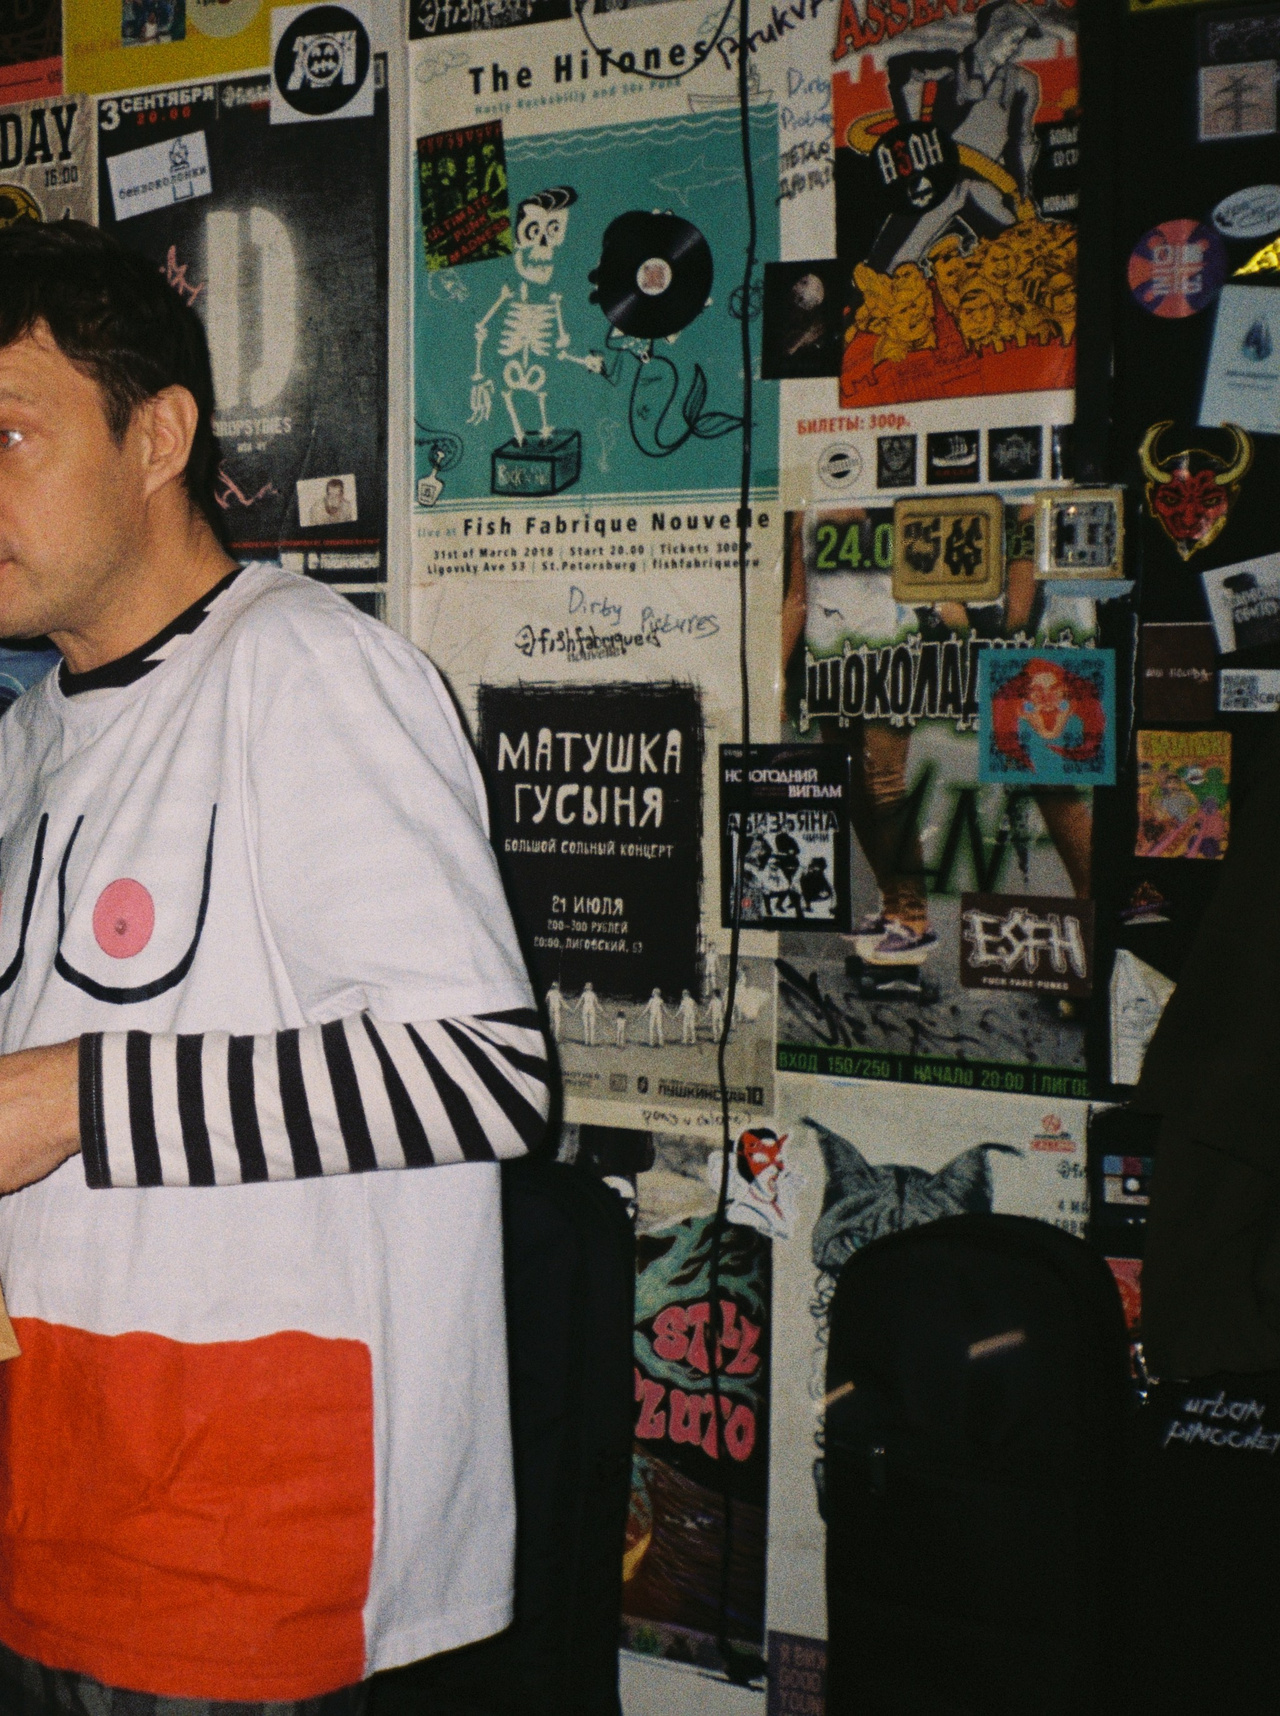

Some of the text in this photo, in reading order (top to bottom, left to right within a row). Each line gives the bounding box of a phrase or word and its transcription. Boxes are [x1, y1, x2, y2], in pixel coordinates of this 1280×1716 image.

[469, 40, 707, 95] The HiTones
[100, 99, 120, 131] 3
[121, 85, 215, 114] СЕНТЯБРЯ
[43, 166, 79, 188] 16:00
[463, 516, 512, 536] Fish
[525, 513, 637, 538] Fabrique
[651, 511, 770, 531] Nouvee
[479, 547, 517, 558] March
[524, 546, 554, 558] 2018
[570, 545, 604, 557] Start
[659, 542, 709, 555] Tickets
[427, 562, 478, 577] Ligovsky
[483, 561, 505, 572] Ave
[652, 557, 760, 571] fishfabriqueru
[496, 727, 684, 776] МАТУШКА
[788, 784, 842, 798] ВИГВАМ
[513, 783, 665, 829] ГУСЫНЯ
[503, 836, 675, 861] БОЛЬШОЙ СОЛЬНЫЙ КОНЦЕРТ
[573, 894, 625, 917] ИЮЛЯ
[590, 919, 630, 935] РУБЛЕЙ
[778, 1050, 820, 1074] ВХОД
[827, 1053, 892, 1079] 150/250
[912, 1062, 975, 1087] НАЧАЛО
